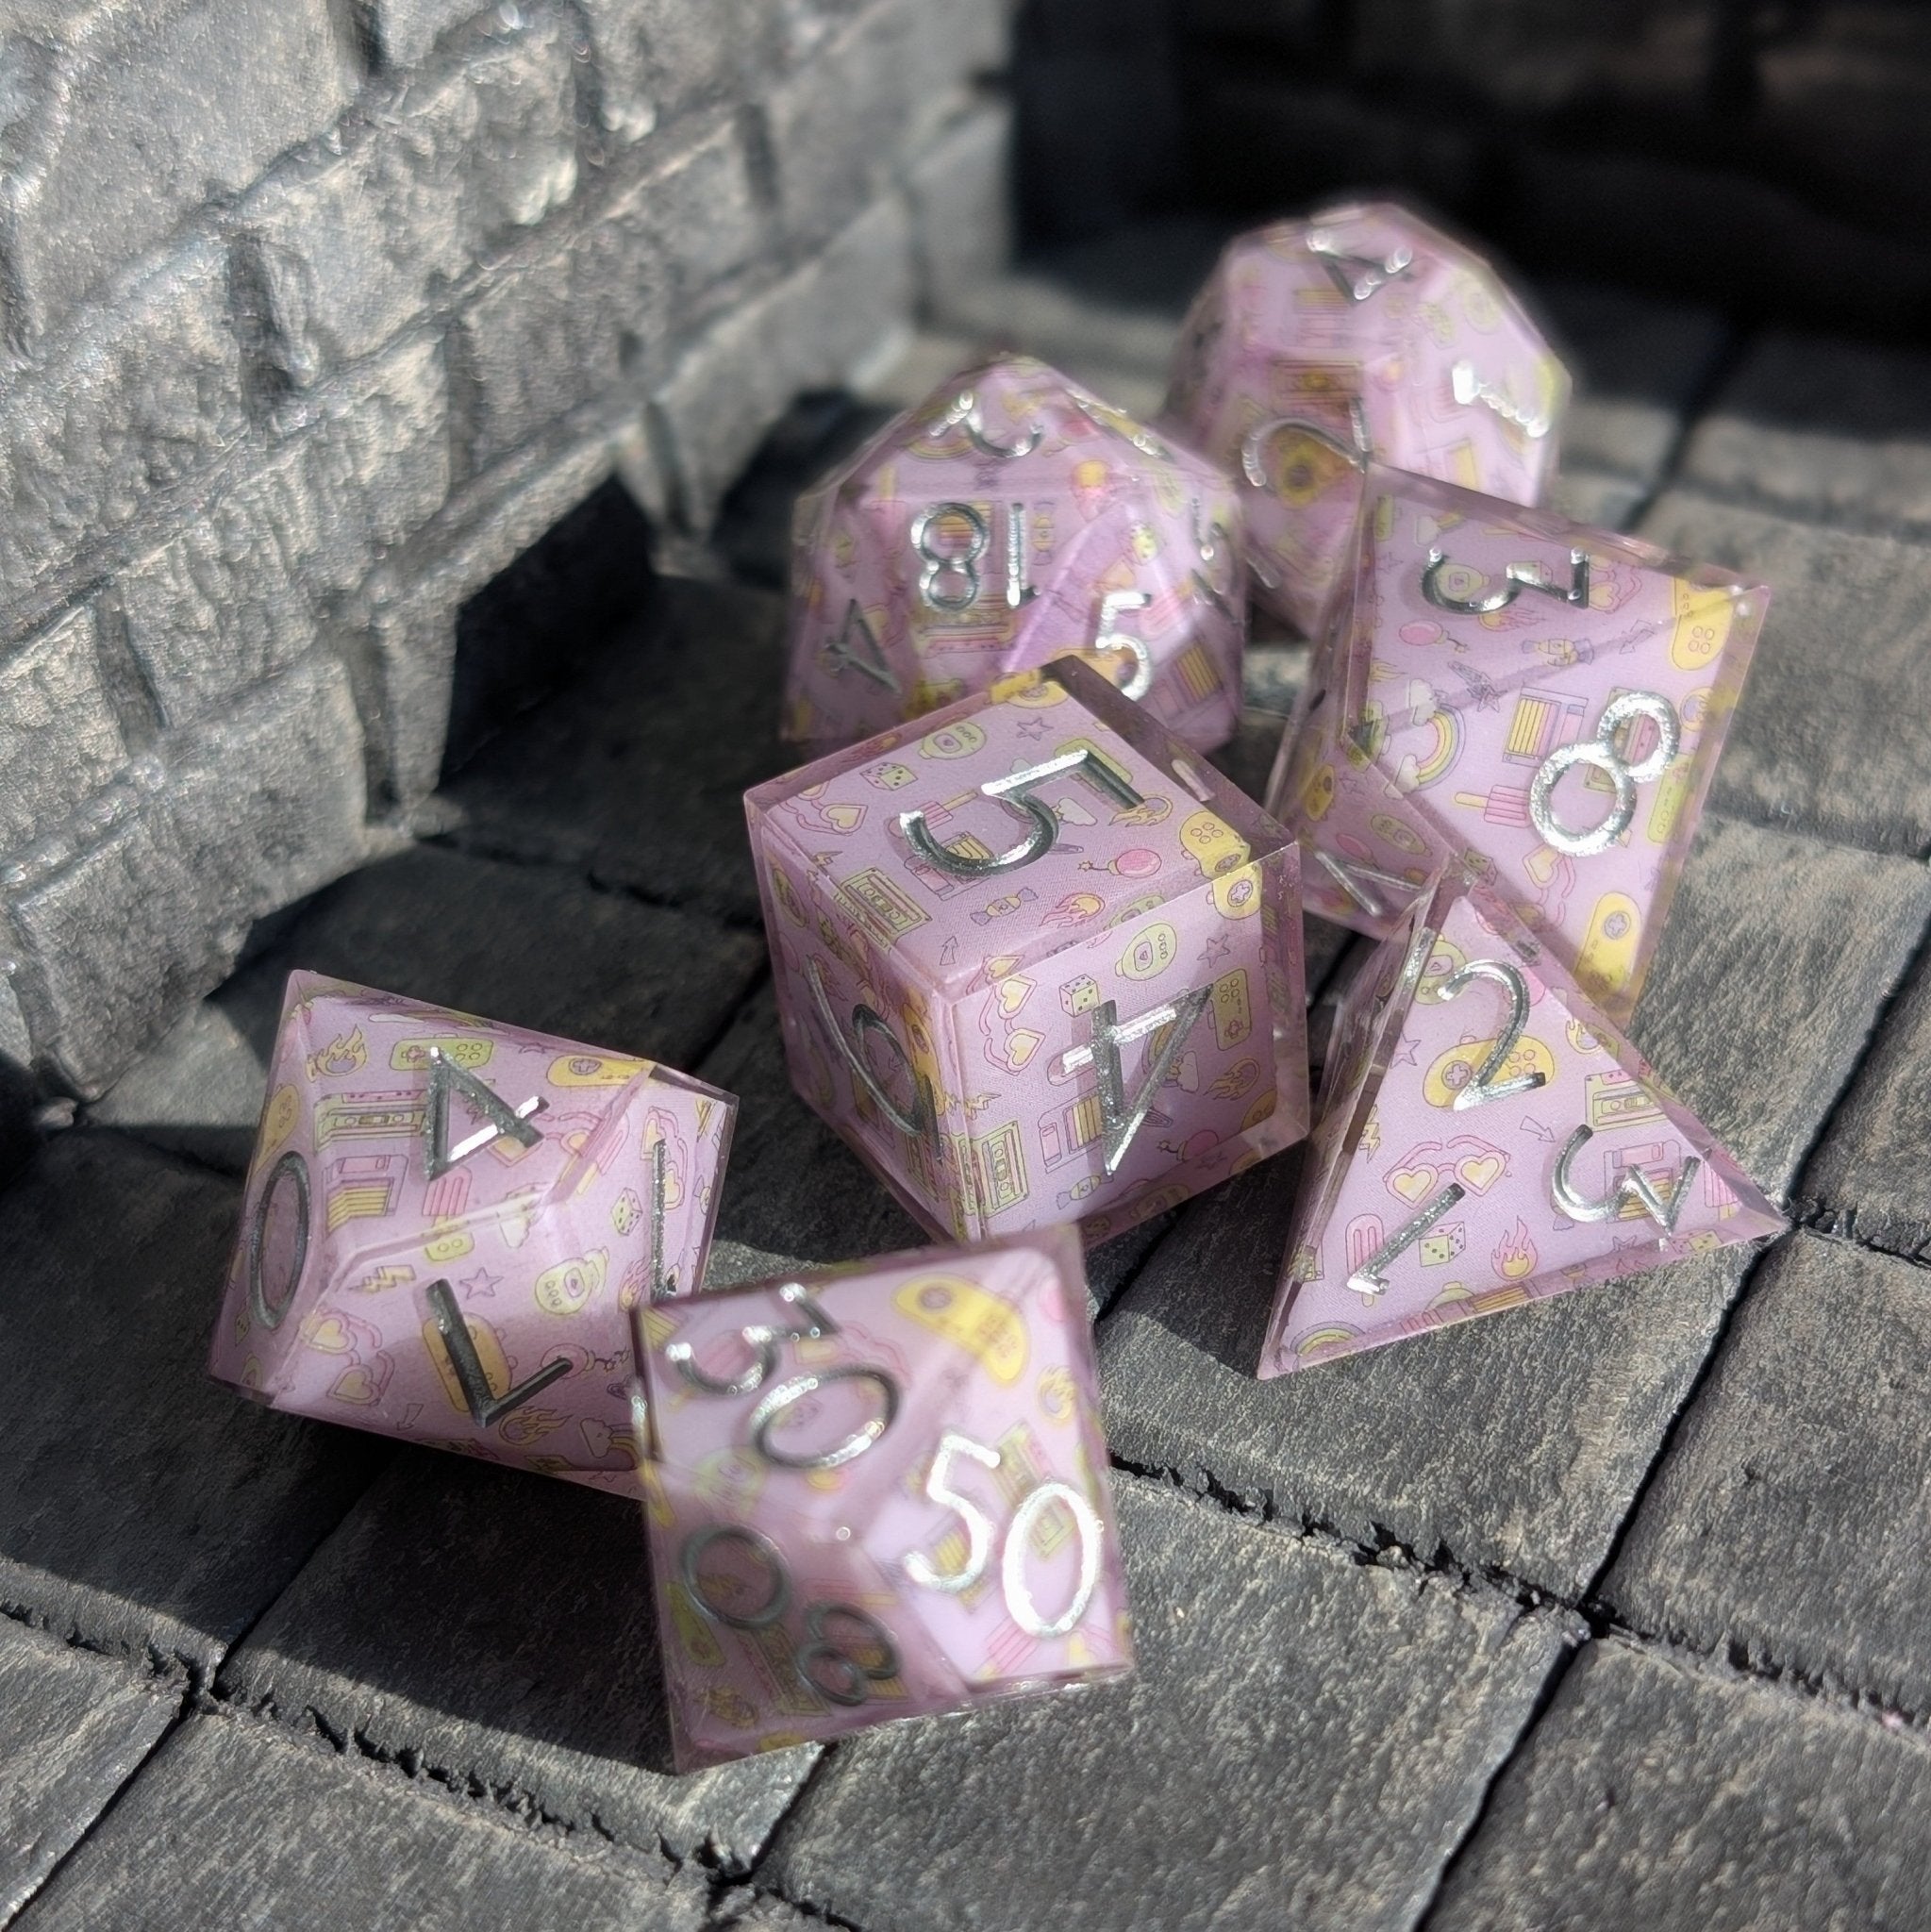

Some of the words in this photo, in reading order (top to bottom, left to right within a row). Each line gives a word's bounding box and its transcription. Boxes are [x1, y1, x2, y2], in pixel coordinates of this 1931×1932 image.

[1307, 227, 1413, 304] 4
[910, 501, 1040, 613] 18
[1094, 591, 1153, 703] 5
[899, 749, 1144, 875] 5
[1529, 690, 1680, 857] 8
[1062, 981, 1214, 1176] 4
[1437, 958, 1546, 1111] 2
[424, 1044, 551, 1183] 4
[1552, 1123, 1700, 1239] 3
[249, 1149, 311, 1330] 0
[1345, 1182, 1466, 1296] 1
[424, 1277, 574, 1427] 7
[665, 1280, 902, 1470] 30
[901, 1432, 1104, 1641] 50
[679, 1523, 903, 1707] 80
